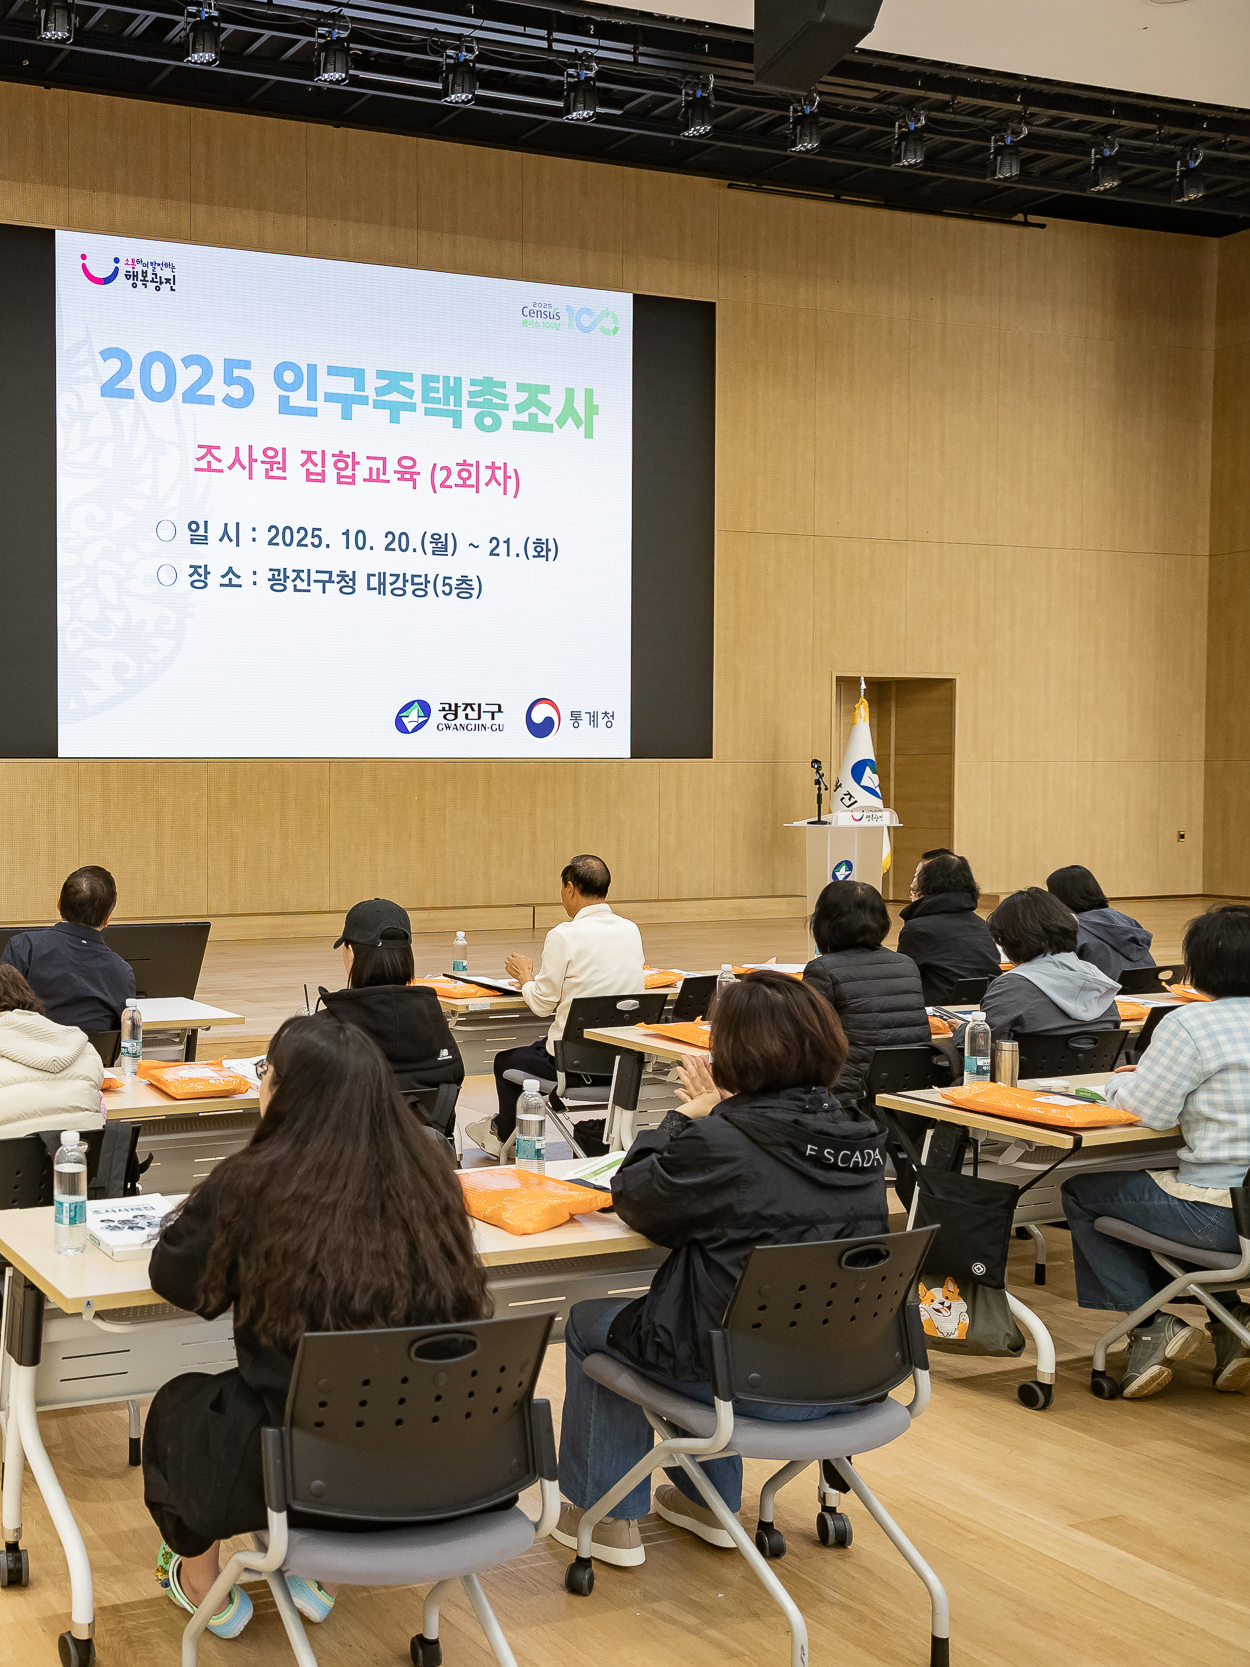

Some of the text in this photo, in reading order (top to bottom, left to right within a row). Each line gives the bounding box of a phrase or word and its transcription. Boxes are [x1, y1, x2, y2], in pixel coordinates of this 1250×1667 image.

[124, 269, 176, 292] 행복광진
[521, 306, 561, 321] Census
[532, 301, 553, 310] 2025
[98, 346, 599, 439] 2025 인구주택총조사
[193, 443, 521, 498] 조사원 집합교육 (2회차)
[266, 523, 331, 549] 2025.
[341, 528, 375, 552] 10.
[384, 529, 458, 558] 20.(월)
[488, 536, 560, 562] 21.(화)
[267, 567, 357, 595] 광진구청
[365, 569, 483, 600] 대강당(5층)
[438, 702, 504, 721] 광진구
[569, 710, 615, 729] 통계청
[805, 1144, 884, 1168] ESCADA
